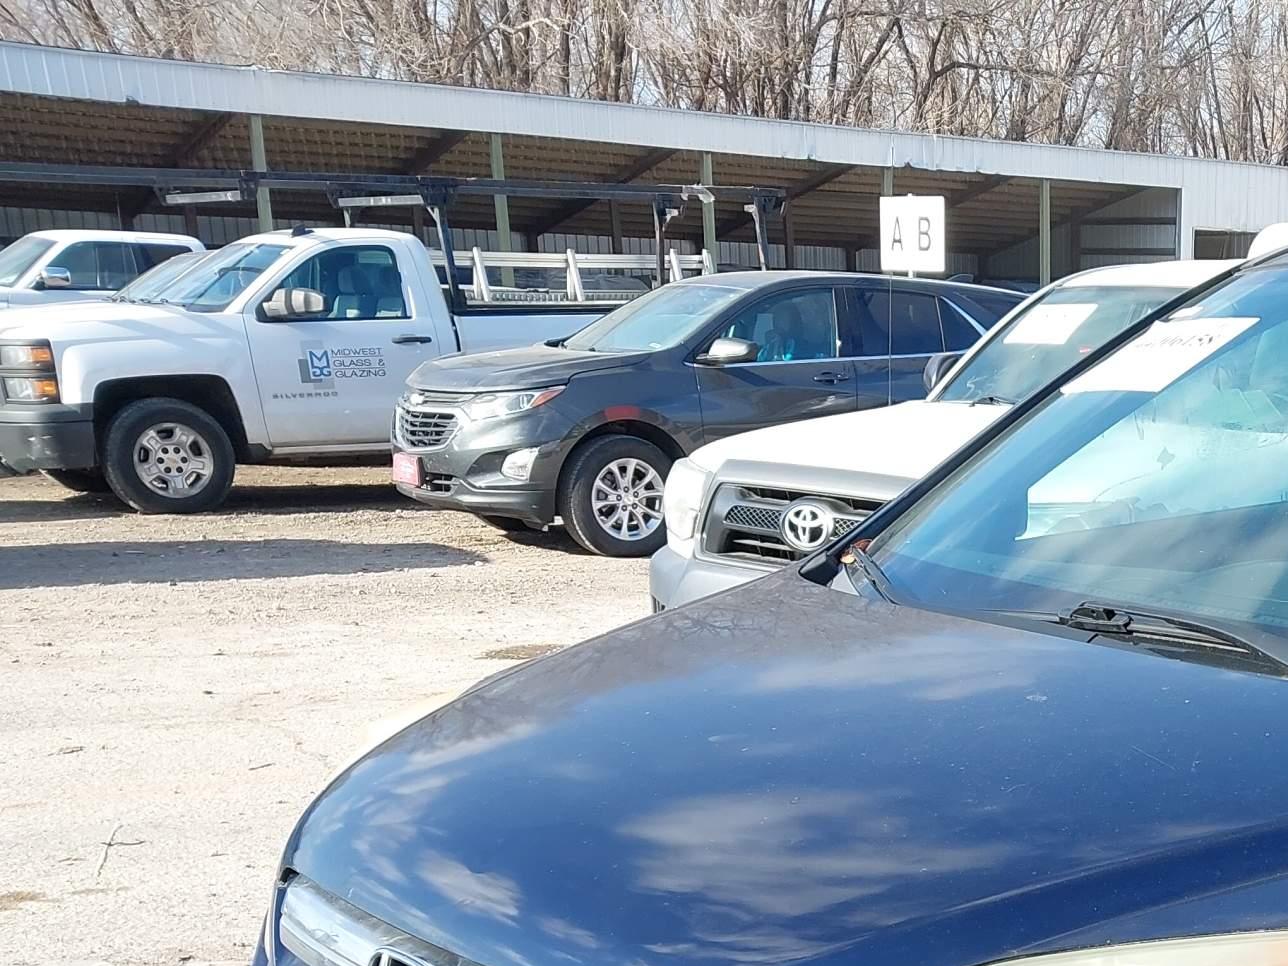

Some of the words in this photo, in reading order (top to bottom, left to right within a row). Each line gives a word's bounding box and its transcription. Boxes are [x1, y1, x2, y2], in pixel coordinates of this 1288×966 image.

[890, 216, 904, 252] A
[918, 216, 932, 252] B
[330, 347, 383, 356] MIDWEST
[333, 359, 372, 368] GLASS
[377, 358, 385, 367] &
[334, 369, 386, 378] GLAZING
